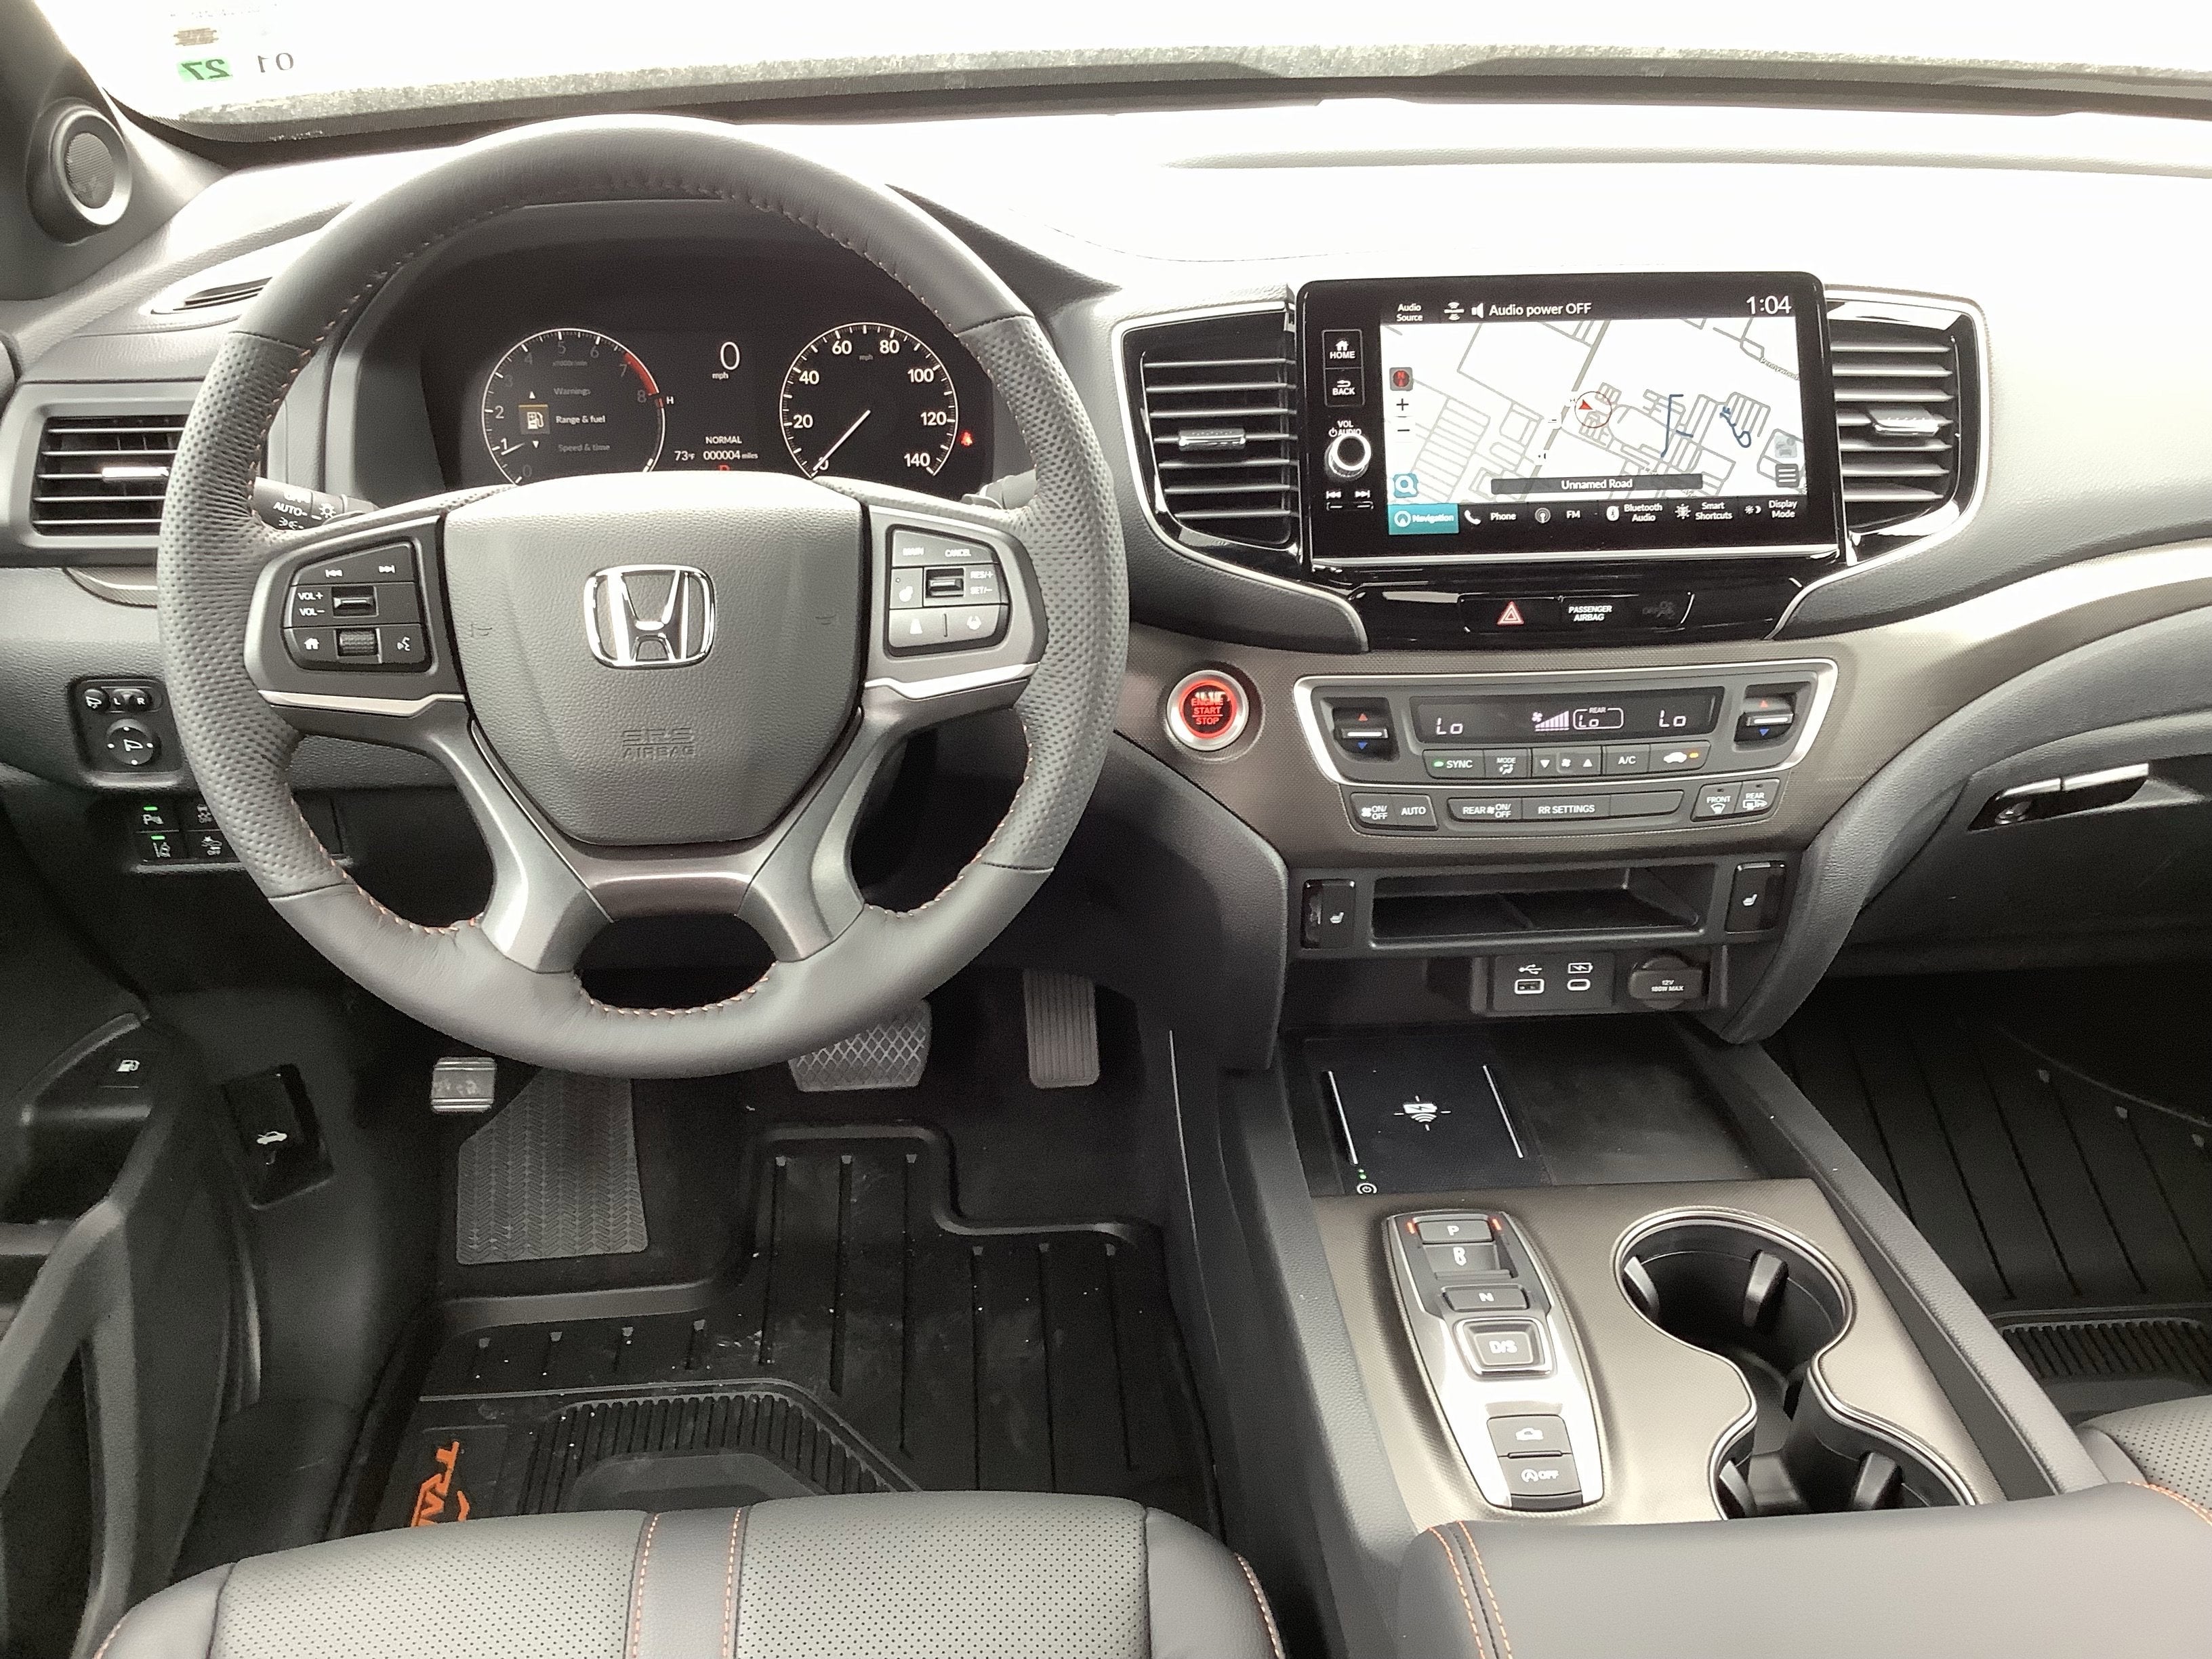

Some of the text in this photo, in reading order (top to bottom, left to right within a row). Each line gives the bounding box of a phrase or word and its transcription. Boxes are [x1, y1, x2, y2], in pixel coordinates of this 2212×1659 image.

[1397, 303, 1422, 312] Audio
[1489, 302, 1592, 317] Audio power OFF
[1746, 295, 1792, 314] 1:04
[1396, 313, 1423, 322] Source
[557, 342, 567, 354] 5
[832, 340, 852, 354] 60
[880, 340, 899, 354] 80
[590, 346, 599, 359] 6
[720, 341, 740, 370] 0
[1330, 351, 1355, 359] HOME
[799, 370, 819, 384] 40
[907, 368, 934, 383] 100
[1332, 386, 1355, 396] BACK
[666, 396, 674, 405] H
[495, 406, 504, 419] 2
[556, 415, 606, 425] Range & fuel
[793, 414, 813, 428] 20
[920, 411, 947, 426] 120
[501, 438, 508, 450] 1
[705, 436, 742, 444] NORMAL
[558, 444, 583, 452] Speed
[703, 450, 741, 460] 000004
[904, 453, 930, 467] 140
[1561, 478, 1633, 489] Unnamed Road
[273, 502, 303, 516] AUTO
[1624, 503, 1663, 513] Bluetooth
[1702, 501, 1725, 510] Smart
[1769, 500, 1797, 510] Display
[1412, 513, 1454, 524] Navigation
[1490, 512, 1517, 520] Phone
[1566, 510, 1581, 519] FM
[1631, 513, 1656, 523] Audio
[1695, 512, 1733, 520] Shortcuts
[1771, 510, 1795, 519] Mode
[1568, 605, 1613, 614] PASSENGER
[1574, 613, 1605, 622] AIRBAG
[113, 697, 121, 705] L
[137, 697, 146, 705] R
[1193, 706, 1222, 714] START
[1195, 717, 1220, 725] STOP
[1578, 714, 1599, 728] Lo
[1658, 710, 1687, 728] Lo
[1435, 717, 1464, 735] Lo
[1446, 760, 1473, 769] SYNC
[1618, 756, 1637, 765] A/C
[1401, 806, 1427, 815] AUTO
[1462, 806, 1486, 815] REAR
[1538, 804, 1595, 814] RR SETTINGS
[1447, 1225, 1460, 1236] P
[1478, 1292, 1495, 1303] N
[1489, 1340, 1518, 1354] D/S
[1538, 1469, 1559, 1479] OFF
